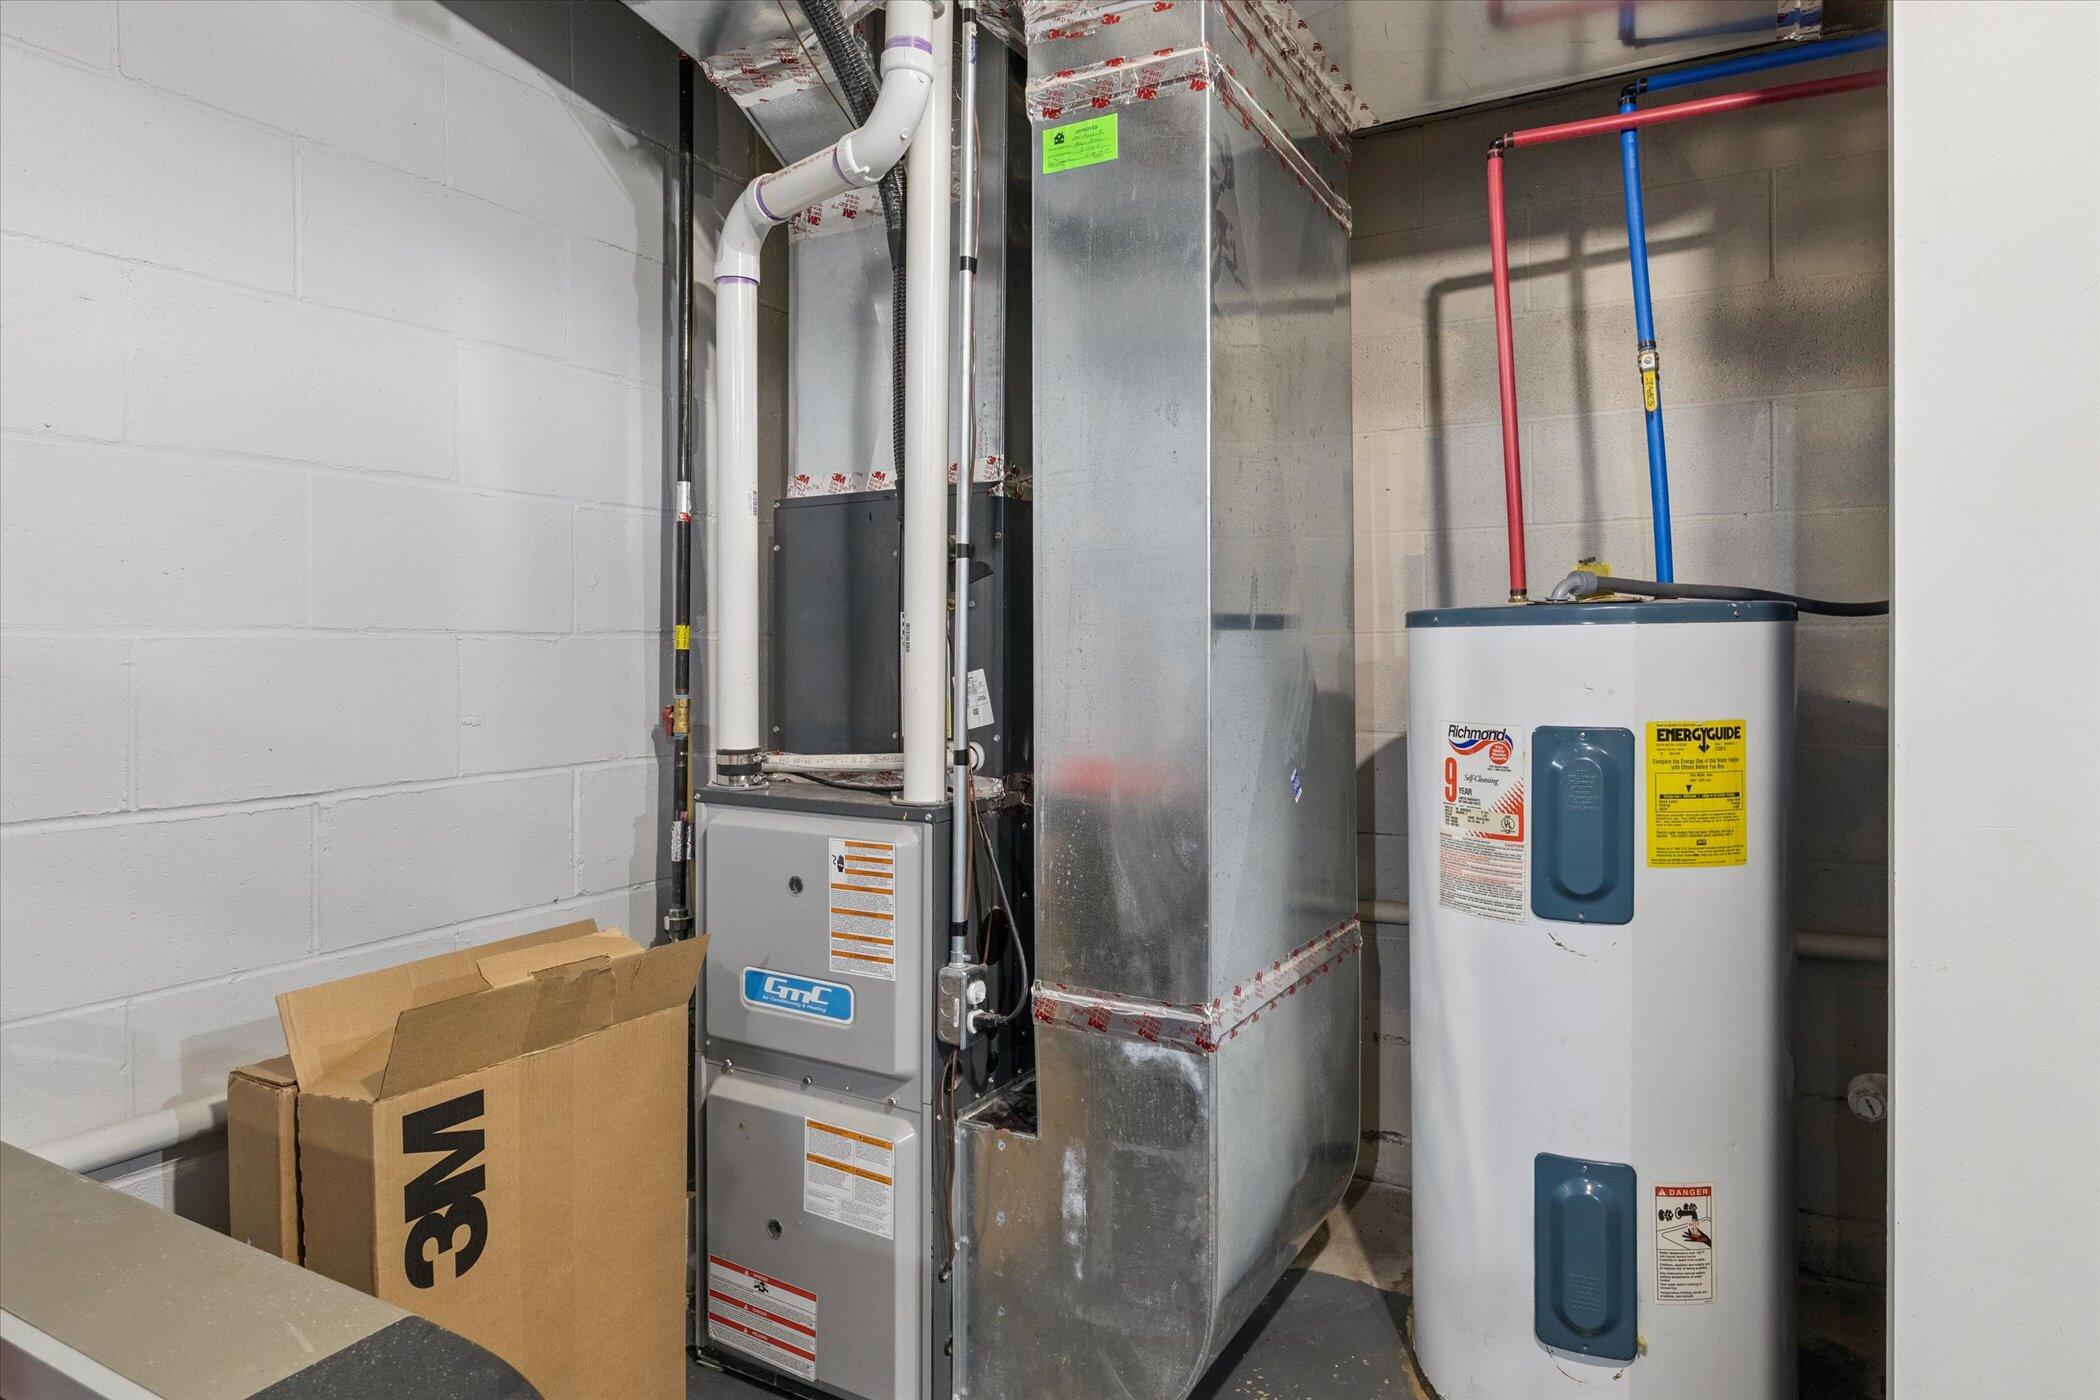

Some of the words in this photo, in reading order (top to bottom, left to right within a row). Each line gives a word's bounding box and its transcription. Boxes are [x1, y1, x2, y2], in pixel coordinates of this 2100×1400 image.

[1101, 13, 1121, 25] 3M
[1091, 97, 1111, 110] 3M
[807, 214, 821, 227] 3M
[842, 208, 857, 220] 3M
[796, 474, 810, 485] 3M
[832, 473, 847, 485] 3M
[871, 470, 886, 482] 3M
[1448, 724, 1507, 742] Richmond
[1444, 757, 1457, 803] 9
[1459, 787, 1473, 796] YEAR
[770, 996, 802, 1008] Conditioning
[807, 1004, 827, 1013] Heating
[1087, 1014, 1108, 1033] 3M
[1138, 1026, 1159, 1042] 3M
[402, 1088, 489, 1290] 3M
[1669, 1188, 1709, 1196] DANGER
